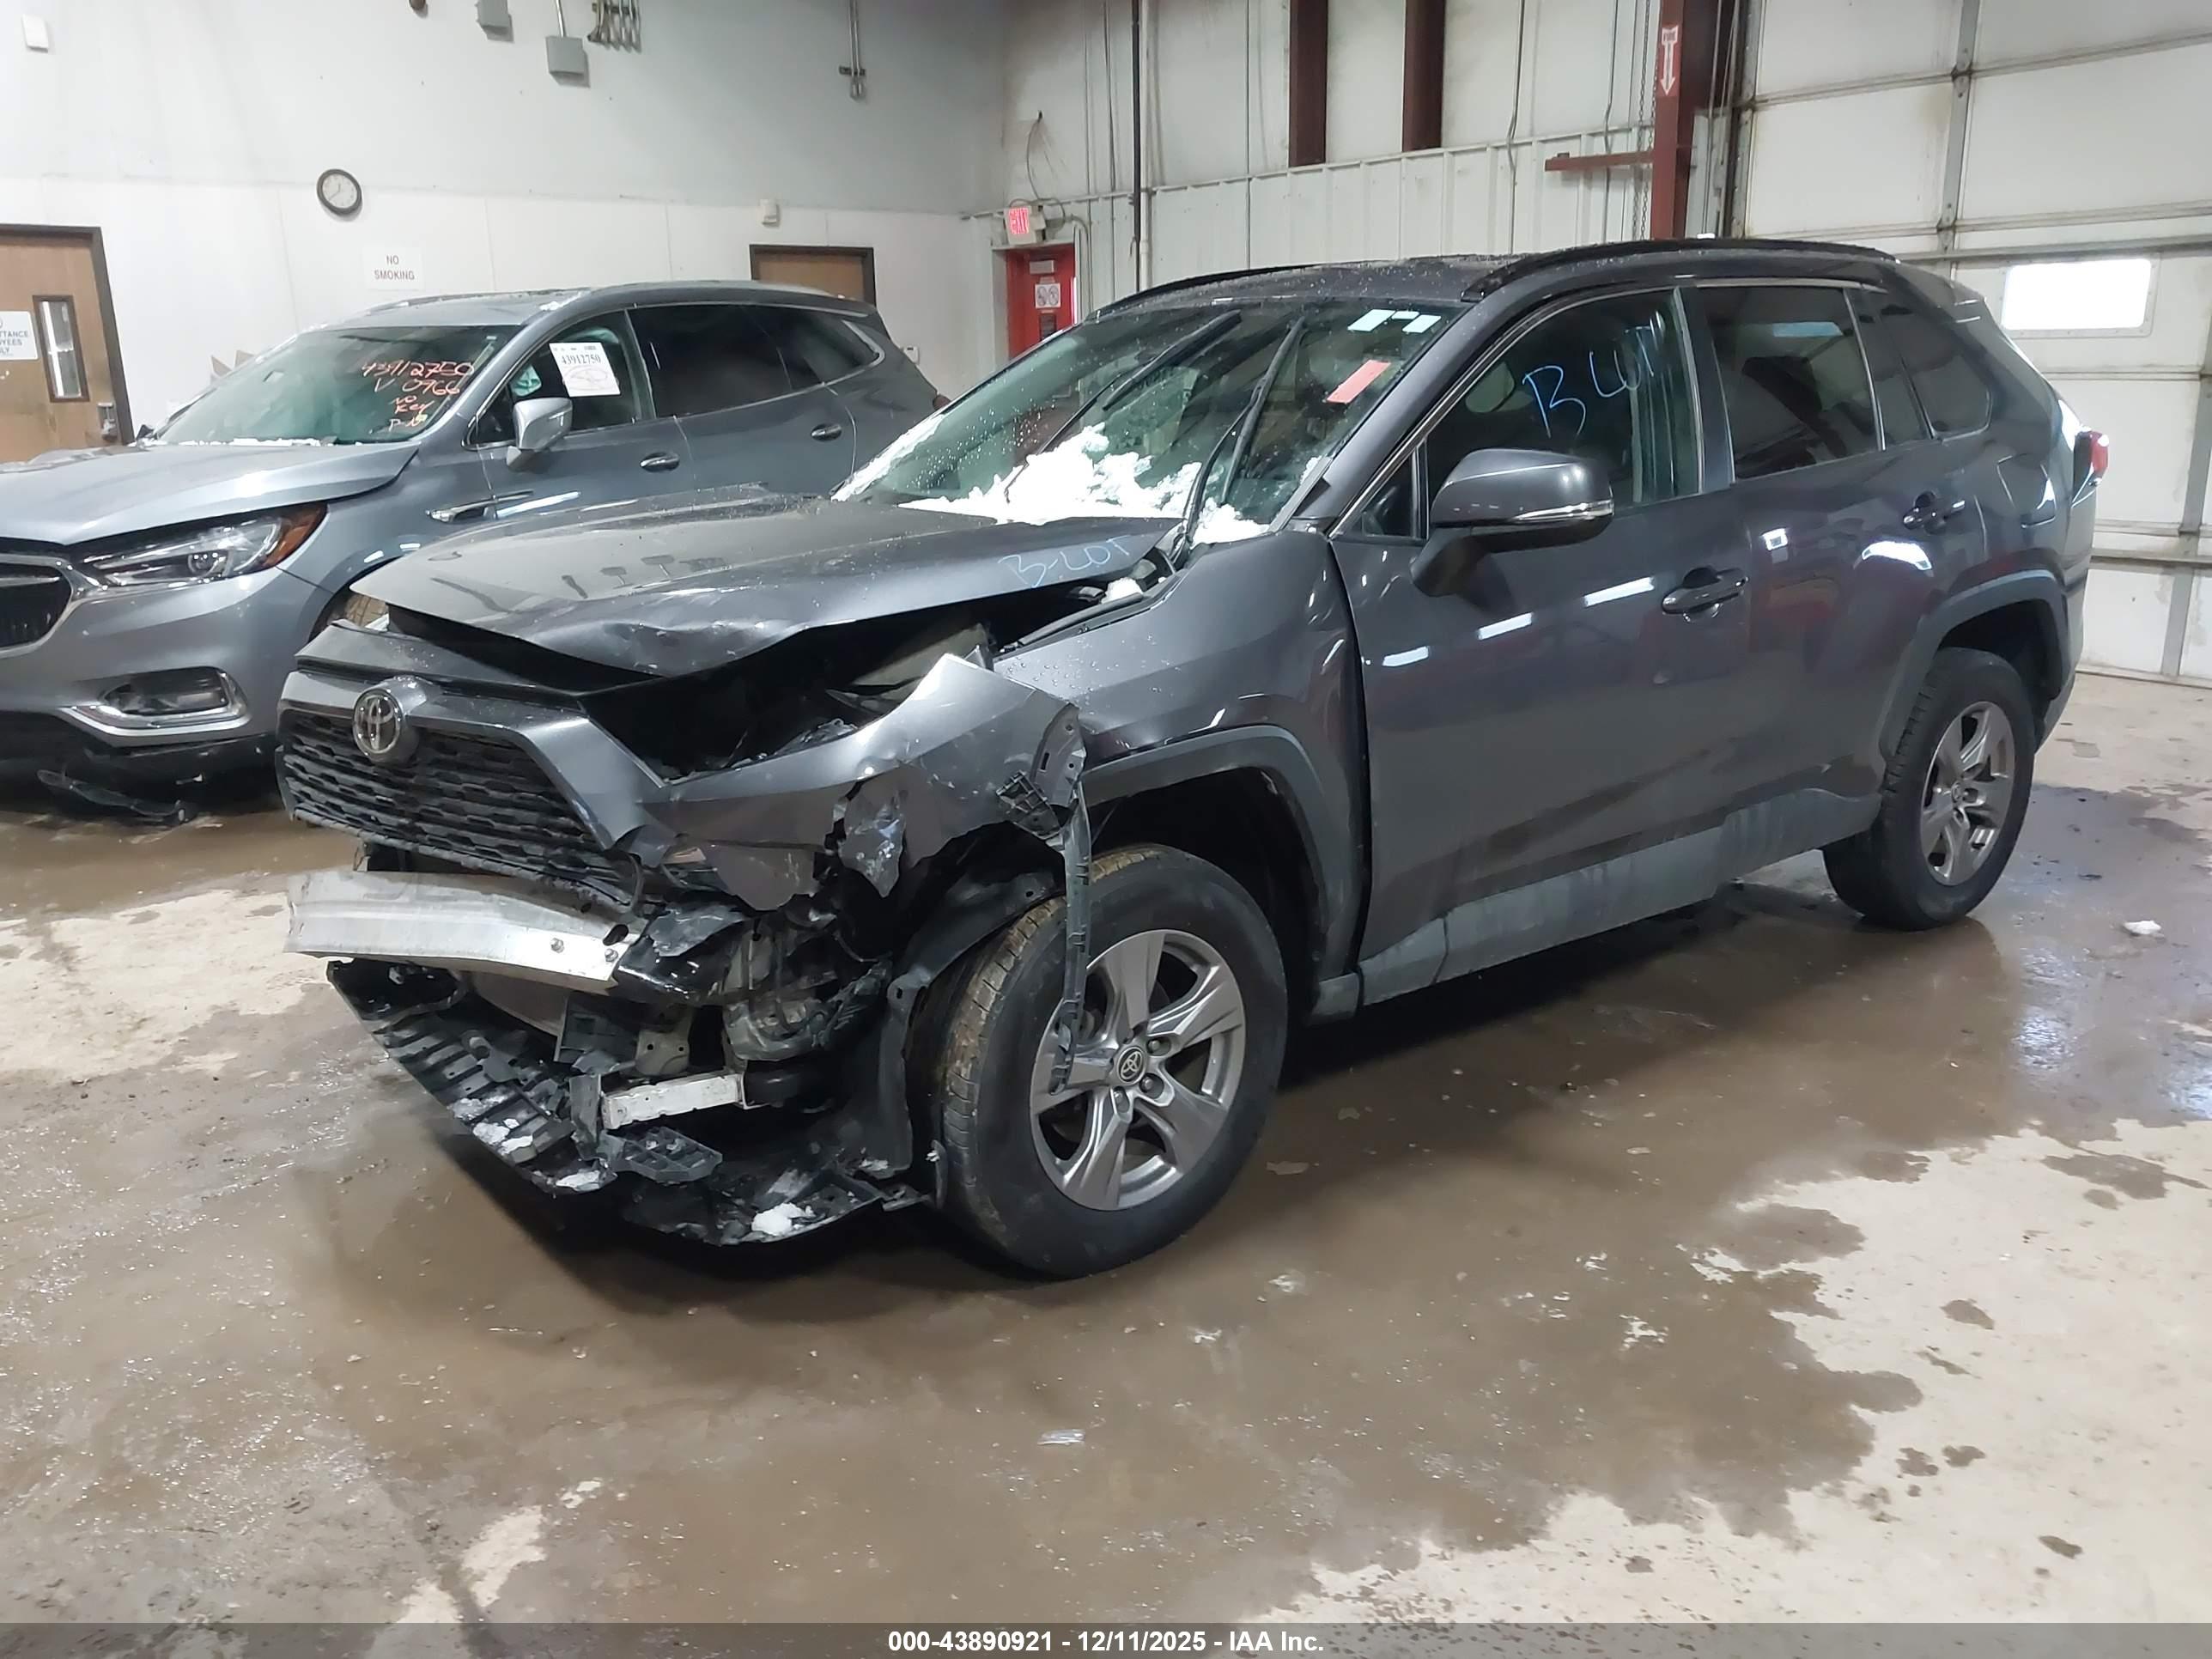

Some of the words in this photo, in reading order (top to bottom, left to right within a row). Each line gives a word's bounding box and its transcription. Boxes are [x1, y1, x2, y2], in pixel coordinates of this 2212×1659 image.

[386, 255, 399, 265] NO
[374, 270, 415, 281] SMOKING
[562, 354, 601, 364] 43912750
[1522, 364, 1587, 439] B
